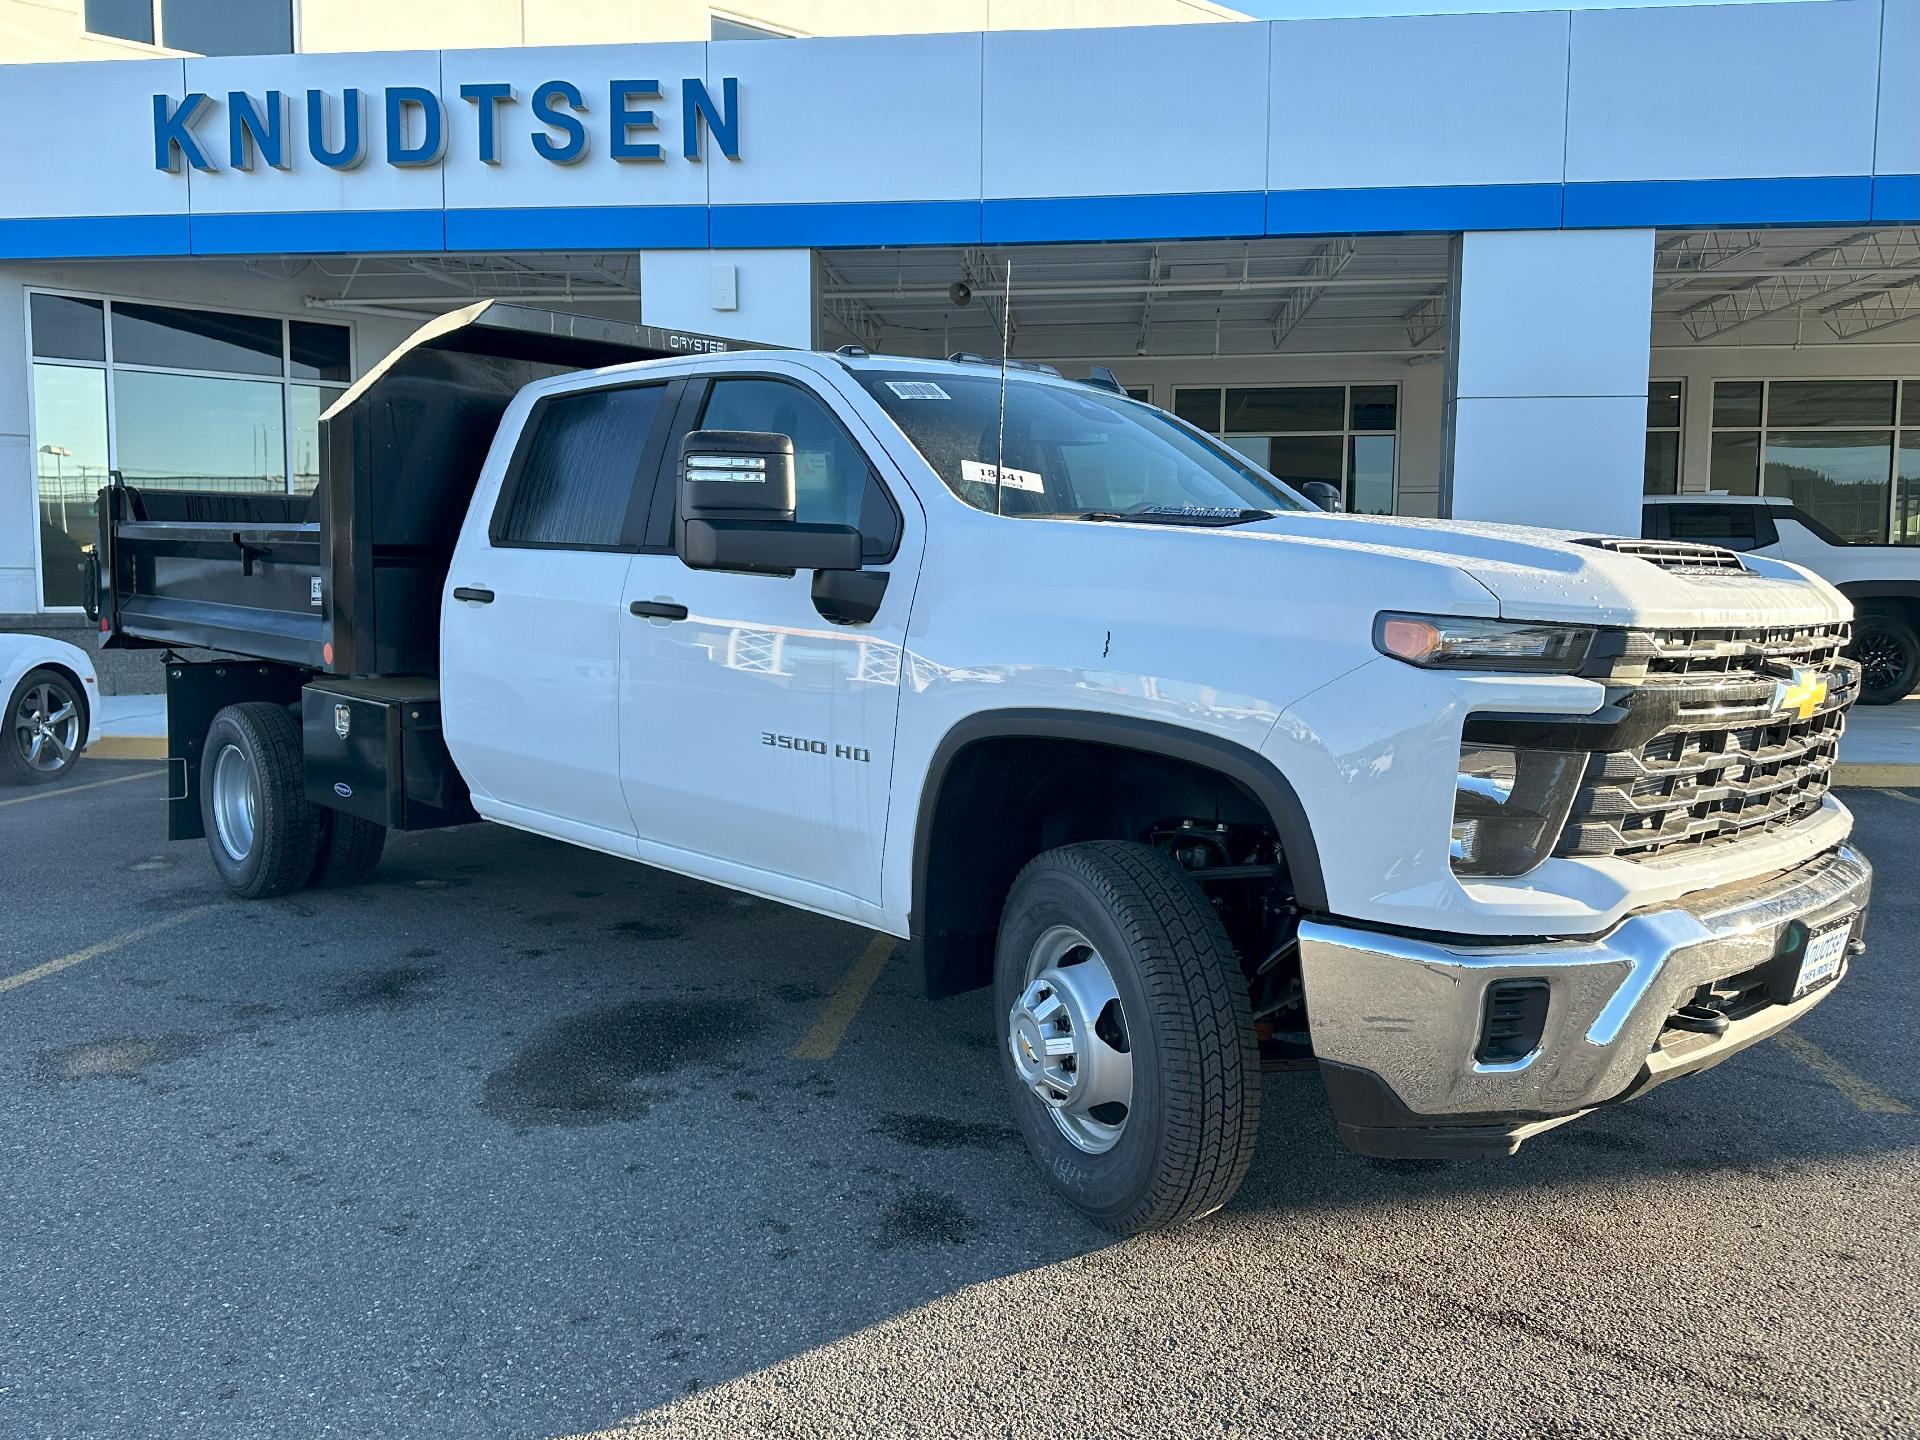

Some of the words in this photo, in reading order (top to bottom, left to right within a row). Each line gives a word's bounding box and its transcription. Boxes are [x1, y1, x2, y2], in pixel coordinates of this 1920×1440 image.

[153, 77, 741, 171] KNUDTSEN
[761, 731, 827, 755] 3500
[835, 743, 871, 763] HD
